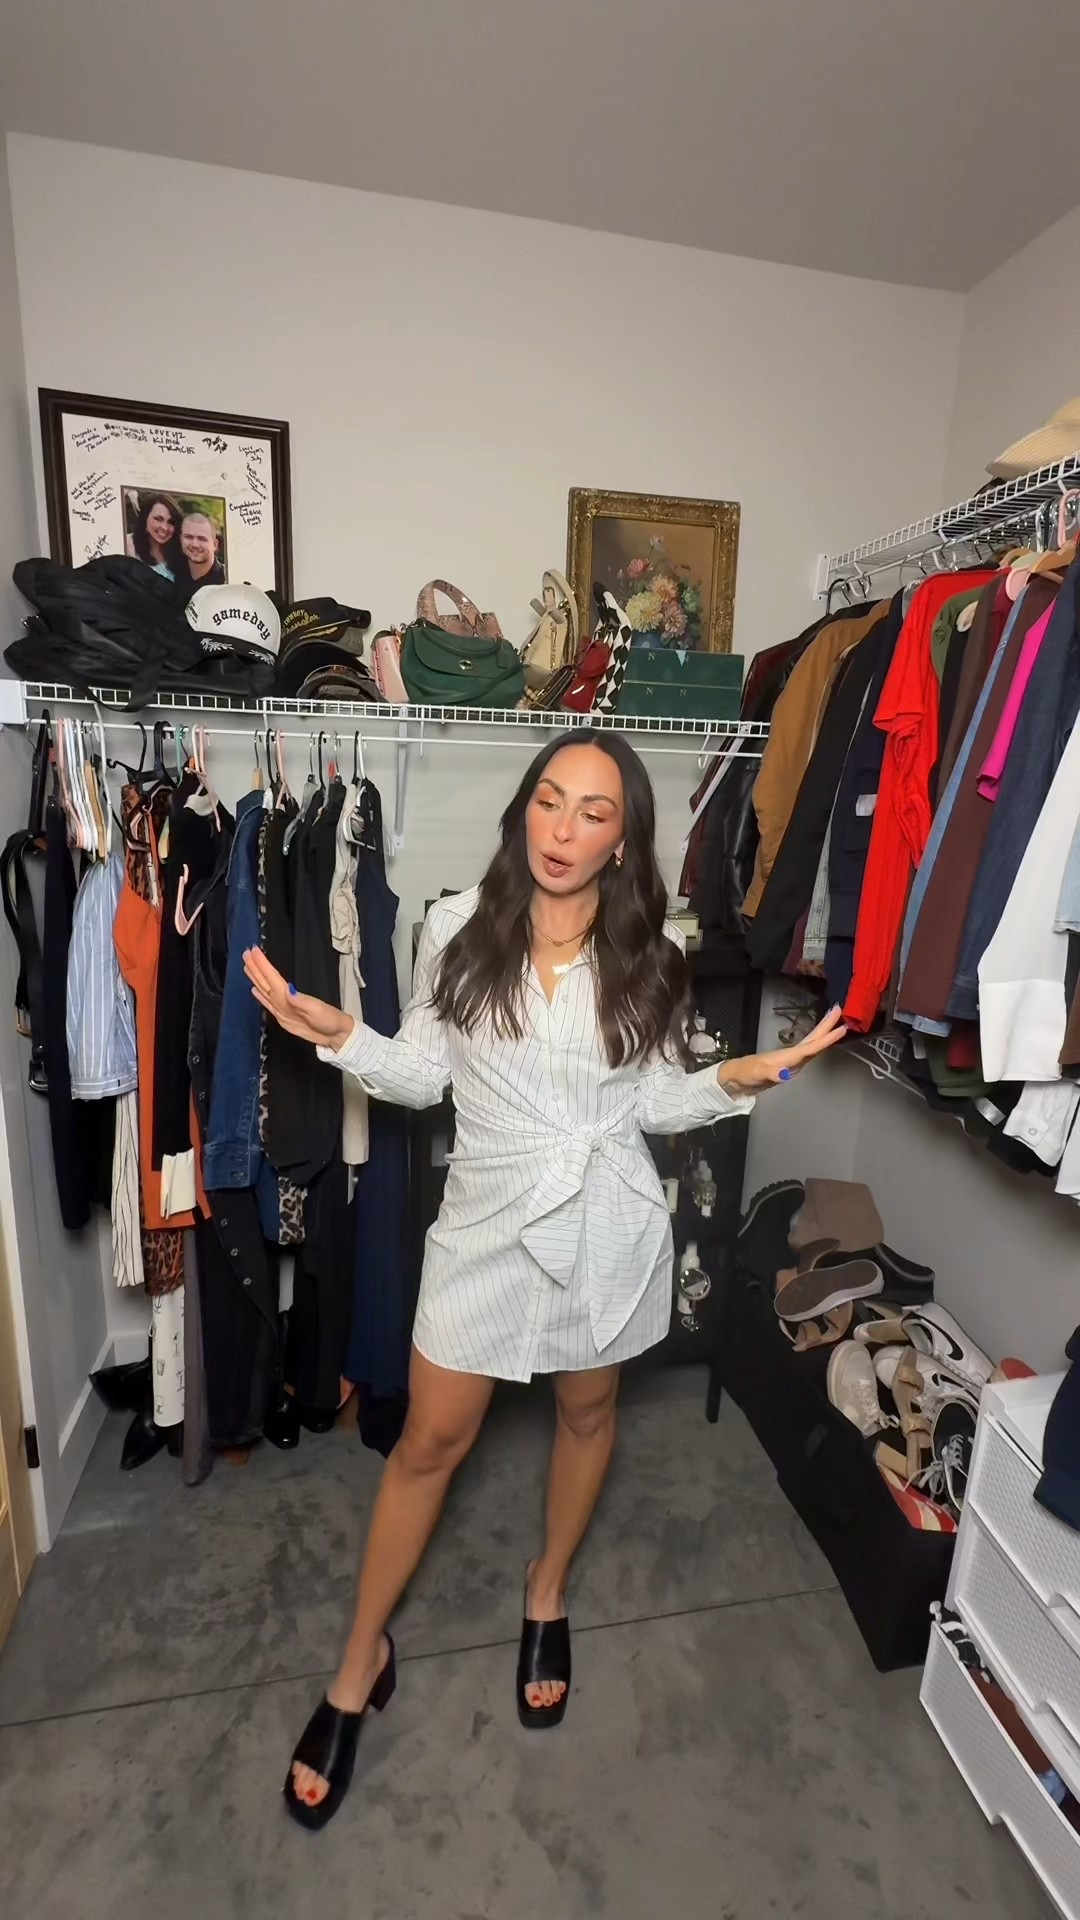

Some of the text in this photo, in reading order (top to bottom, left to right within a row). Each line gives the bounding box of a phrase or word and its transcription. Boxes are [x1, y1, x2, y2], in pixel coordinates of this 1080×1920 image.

[149, 428, 170, 437] LOVE
[158, 445, 196, 454] TRACIE
[212, 608, 271, 641] gameday
